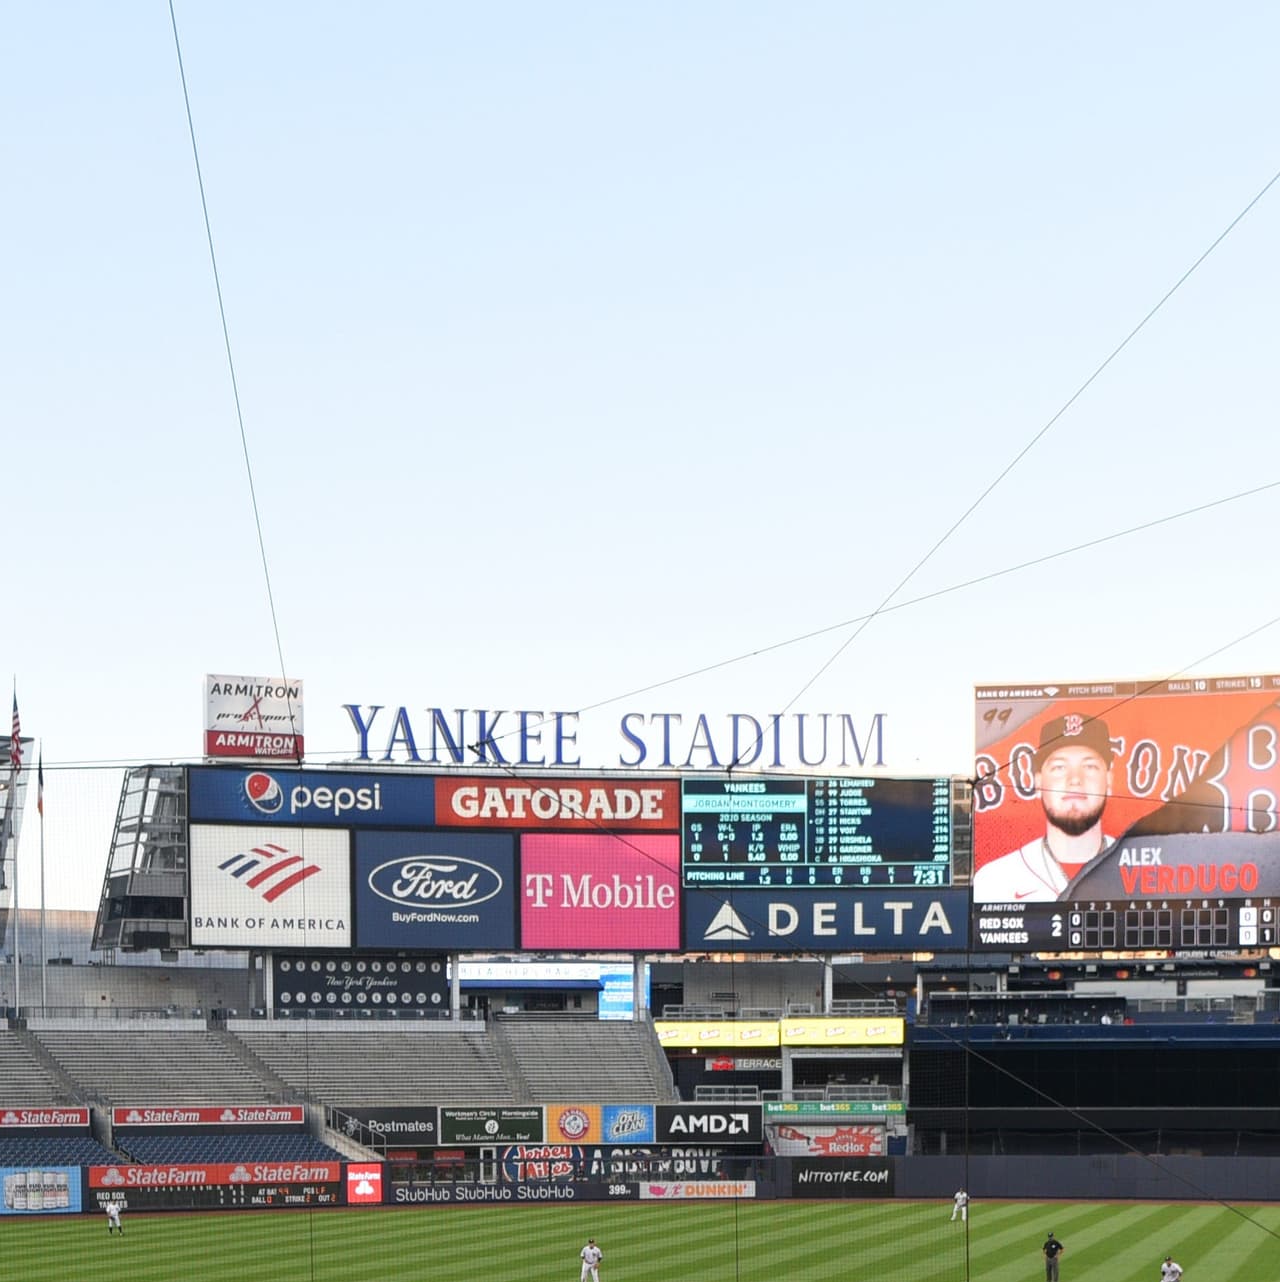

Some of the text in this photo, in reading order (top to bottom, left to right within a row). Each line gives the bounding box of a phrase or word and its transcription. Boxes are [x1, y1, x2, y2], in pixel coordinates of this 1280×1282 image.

[1194, 680, 1206, 691] 10
[1250, 677, 1262, 688] 15
[210, 683, 299, 699] ARMITRON
[216, 734, 295, 749] ARMITRON
[340, 703, 888, 770] YANKEE STADIUM
[724, 783, 767, 793] YANKEES
[291, 783, 381, 816] pepsi
[451, 788, 665, 821] GATORADE
[693, 800, 797, 808] JORDAN MONTGOMERY
[741, 814, 773, 822] SEASON
[780, 823, 797, 832] ERA
[1119, 847, 1162, 866] ALEX
[392, 860, 480, 900] Ford
[687, 872, 745, 882] PITCHING LINE
[913, 870, 944, 885] 7:31
[1119, 863, 1259, 894] VERDUGO
[561, 873, 675, 909] Mobile
[981, 903, 1026, 912] ARMITRON
[194, 916, 347, 932] BANK OF AMERICA
[391, 911, 480, 925] BuyFordNow.com
[768, 901, 953, 936] DELTA
[979, 918, 1024, 929] RED SOX
[979, 931, 1028, 944] YANKEES
[737, 1059, 782, 1069] TERRACE
[768, 1103, 798, 1112] bet365
[819, 1103, 851, 1112] bet365
[871, 1103, 902, 1112] bet365
[369, 1120, 434, 1132] Postmates
[670, 1114, 728, 1133] AMD
[798, 1169, 889, 1184] NITTOTIRE.COM
[396, 1187, 450, 1202] StubHub
[455, 1186, 512, 1200] StubHub
[517, 1184, 575, 1199] StubHub
[608, 1185, 625, 1195] 399
